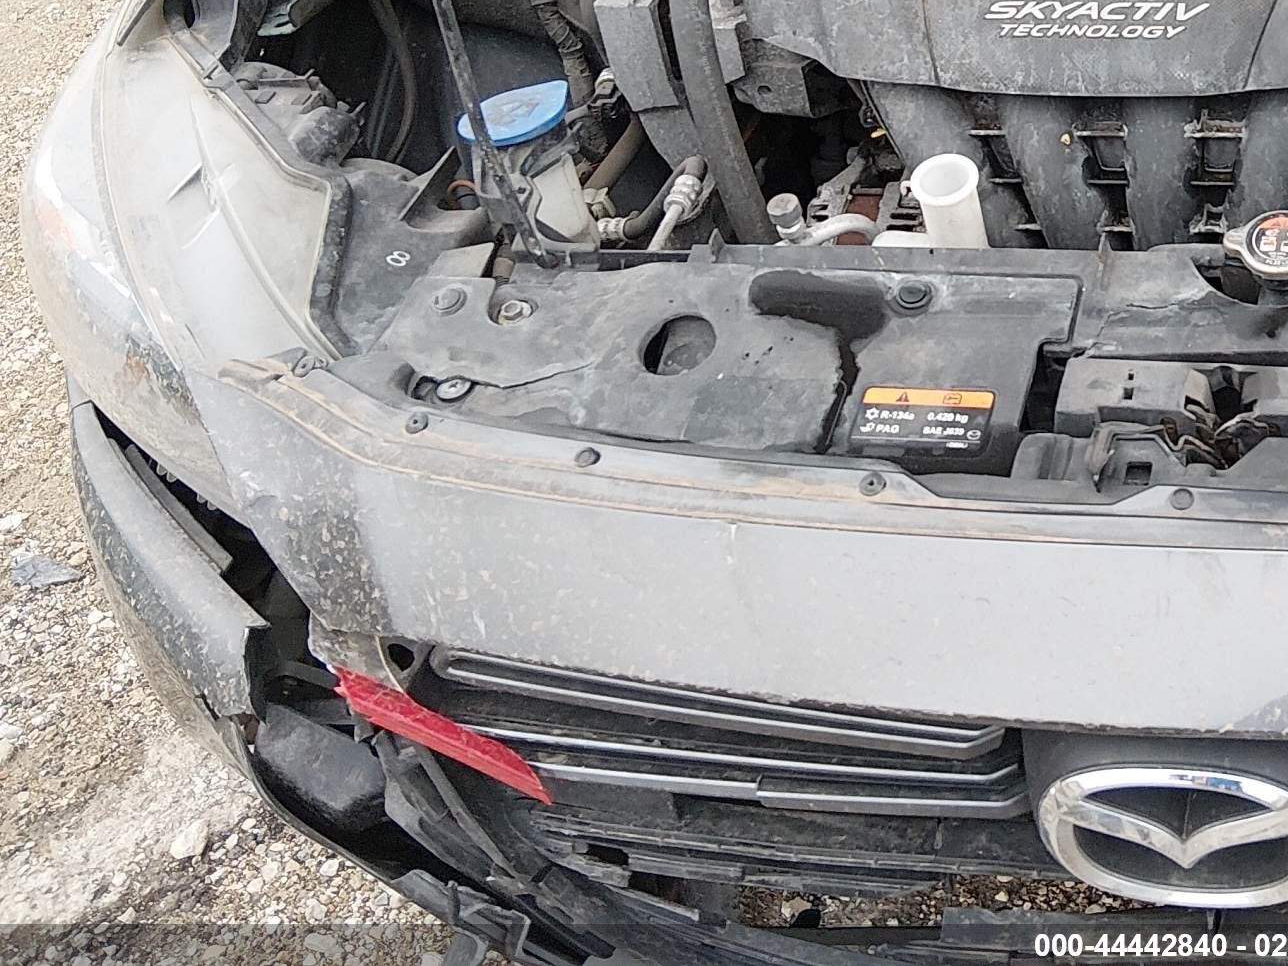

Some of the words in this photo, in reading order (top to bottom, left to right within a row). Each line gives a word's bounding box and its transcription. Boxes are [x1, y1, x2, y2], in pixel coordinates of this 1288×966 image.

[984, 0, 1210, 21] SKYACTIV
[999, 23, 1186, 38] TECHNOLOGY
[880, 410, 915, 420] R-134a
[955, 413, 969, 424] kg
[876, 424, 900, 433] PAG
